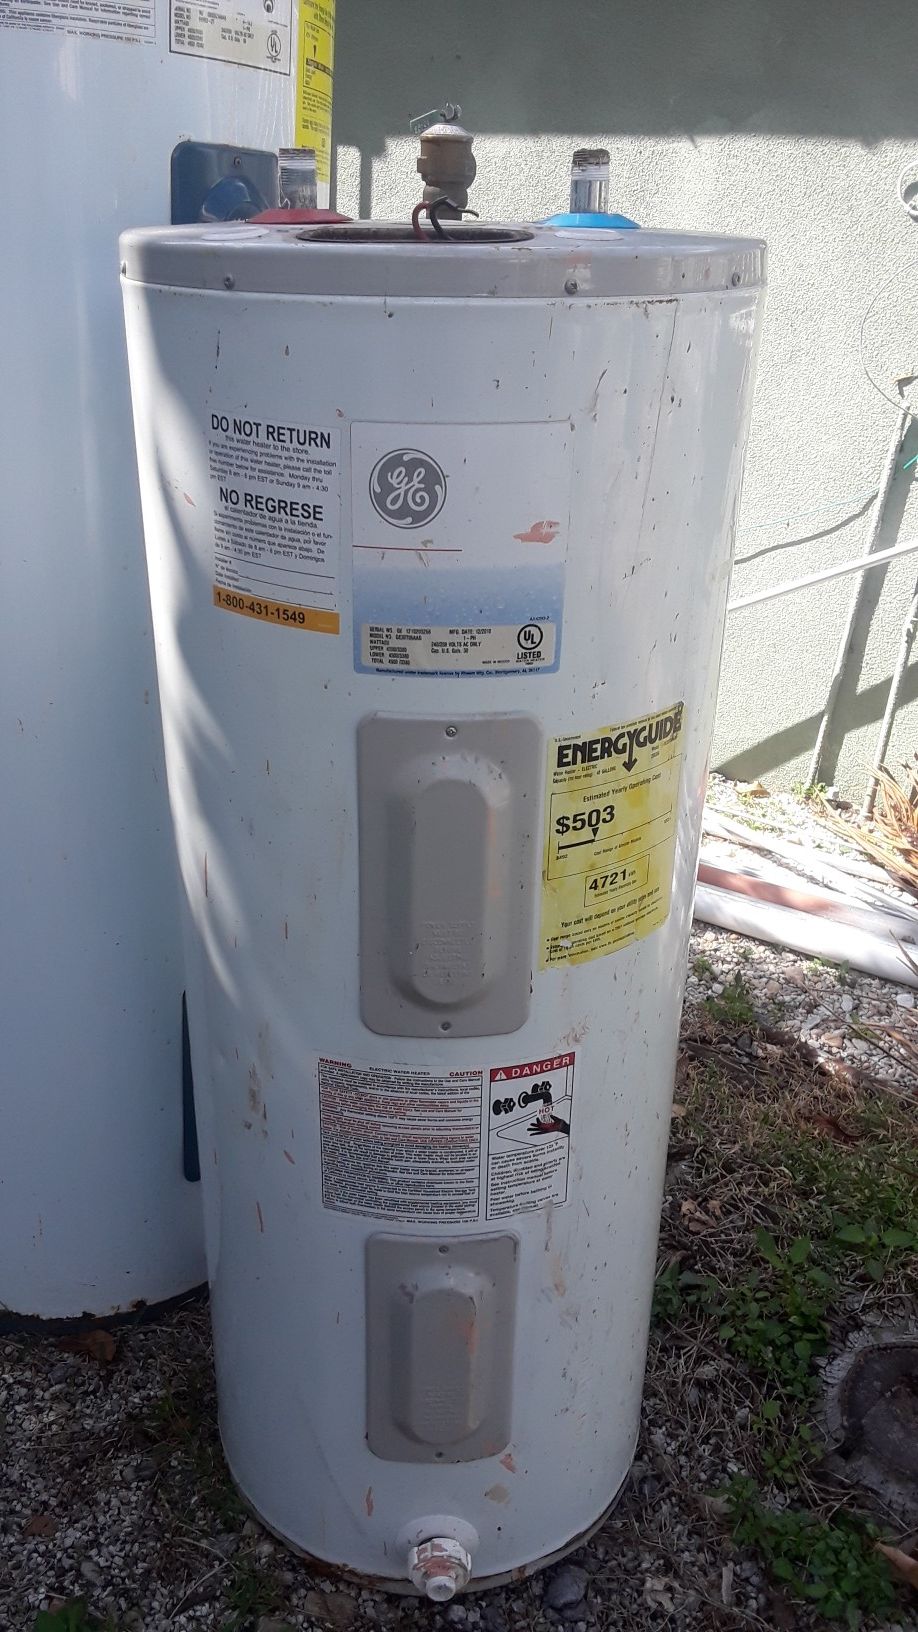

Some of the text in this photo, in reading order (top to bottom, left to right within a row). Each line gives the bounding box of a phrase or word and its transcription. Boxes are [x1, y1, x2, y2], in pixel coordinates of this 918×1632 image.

[212, 414, 331, 449] DO NOT RETURN
[252, 440, 272, 450] heater
[280, 444, 290, 452] the
[292, 447, 310, 455] store.
[259, 452, 282, 460] problems
[306, 458, 336, 467] installation
[276, 479, 295, 488] Sunday
[289, 472, 310, 482] Monday
[220, 487, 323, 521] NO REGRESE
[268, 515, 283, 523] agua
[217, 592, 305, 624] 1-800-431-1549
[524, 630, 536, 644] UL
[517, 651, 541, 659] LISTED
[557, 712, 681, 769] ENERGYGUIDE
[583, 791, 610, 803] Estimated
[612, 785, 627, 795] Yearly
[629, 778, 651, 790] Operating
[555, 804, 615, 836] $503
[589, 869, 627, 891] 4721
[594, 909, 610, 920] depend
[319, 1057, 352, 1068] WARNING
[512, 1057, 570, 1077] DANGER
